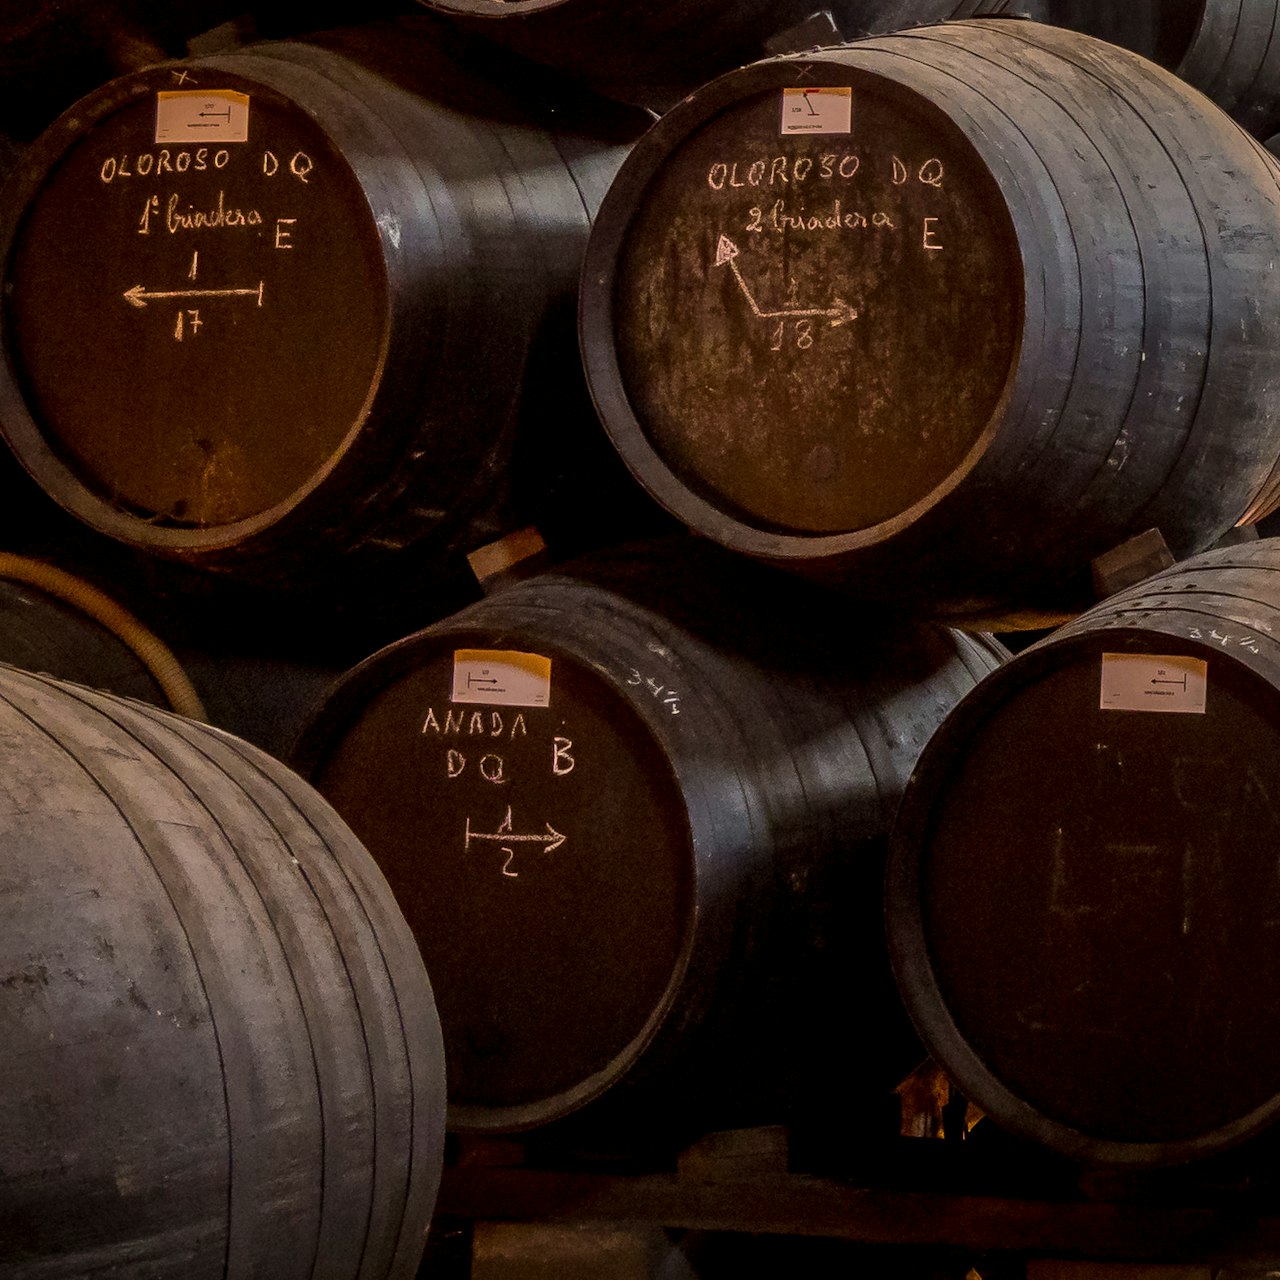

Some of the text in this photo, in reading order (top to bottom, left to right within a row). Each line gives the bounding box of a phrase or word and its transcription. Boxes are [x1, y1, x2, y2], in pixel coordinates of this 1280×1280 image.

[101, 148, 230, 183] OLOROSO
[708, 155, 860, 190] OLOROSO
[275, 218, 297, 249] E
[923, 217, 943, 249] E
[188, 251, 198, 280] 1
[174, 309, 203, 342] 17
[771, 320, 813, 351] 18
[553, 736, 575, 775] B
[501, 847, 518, 877] 2
